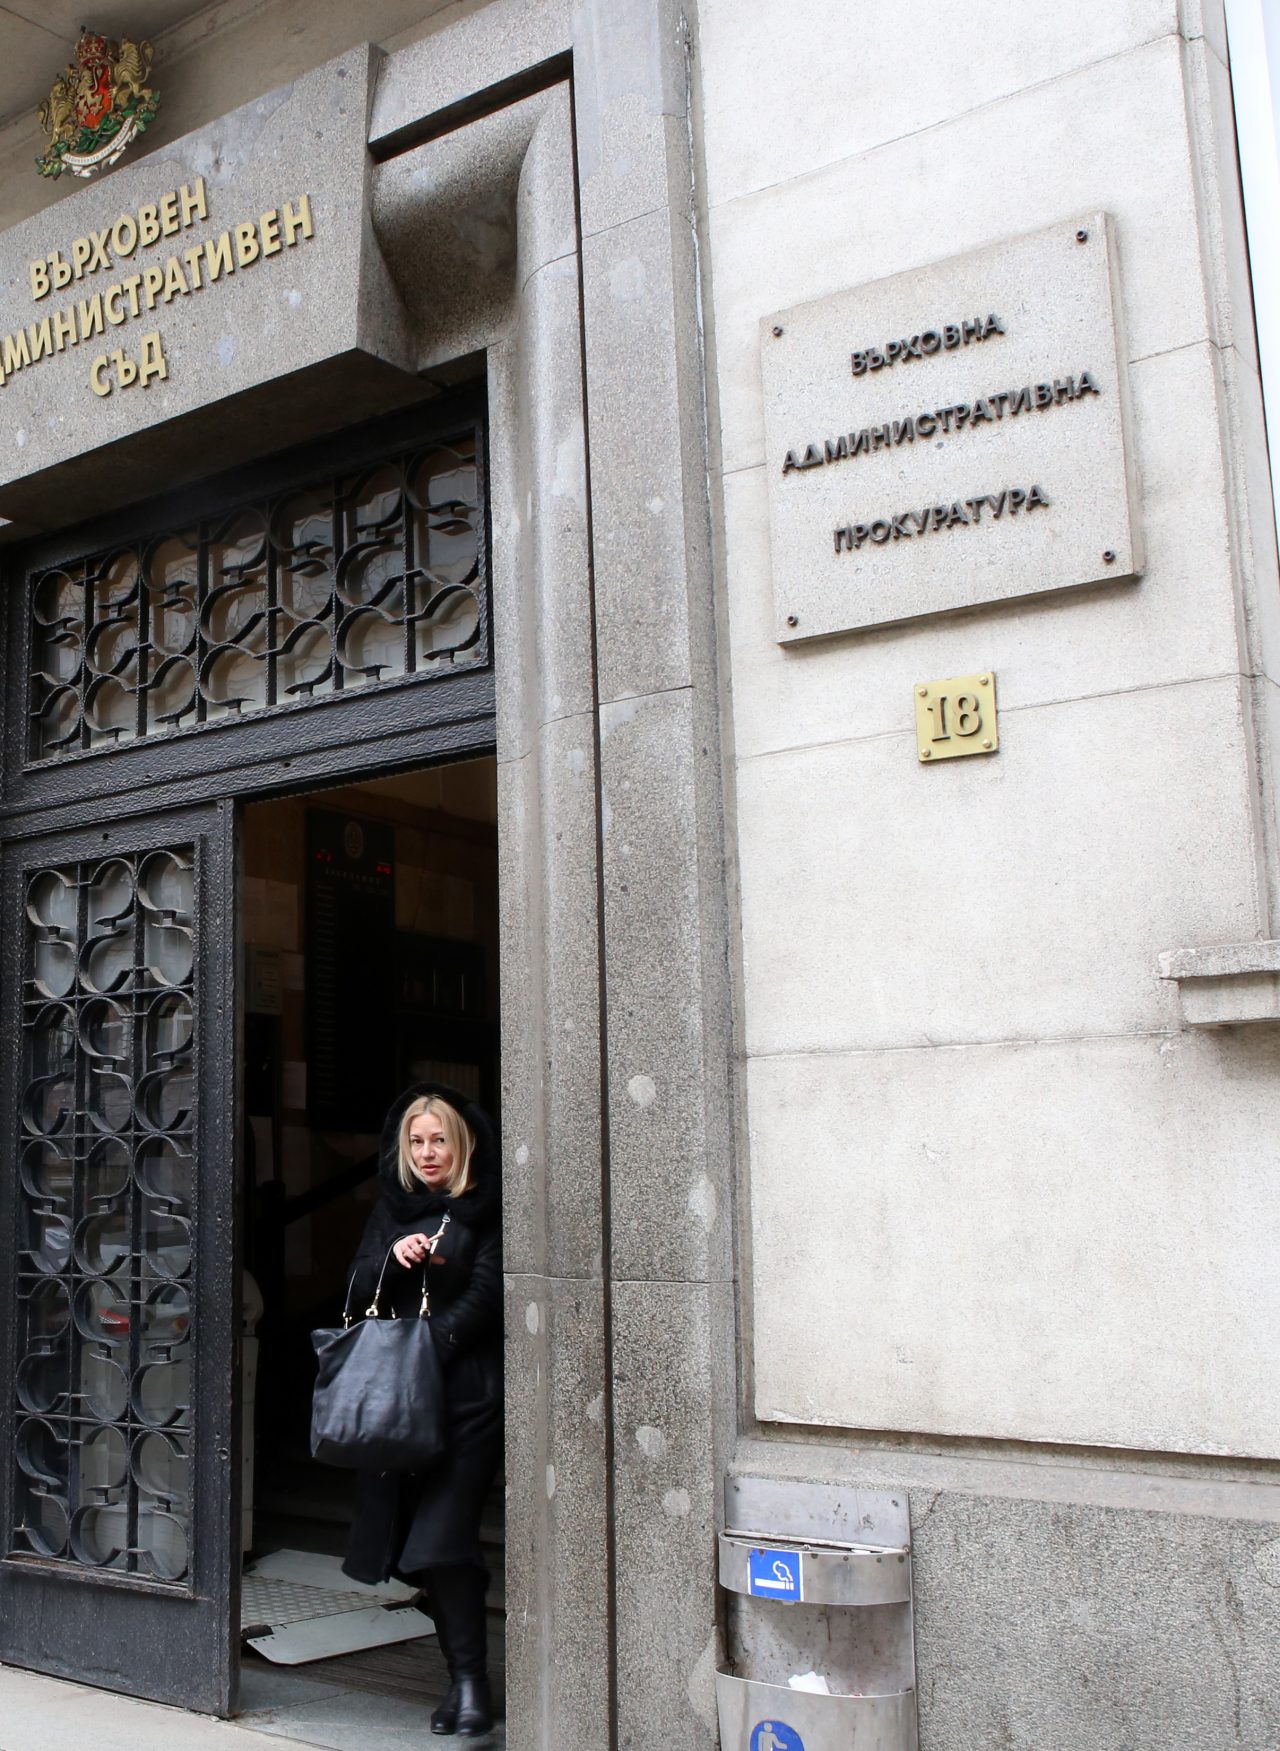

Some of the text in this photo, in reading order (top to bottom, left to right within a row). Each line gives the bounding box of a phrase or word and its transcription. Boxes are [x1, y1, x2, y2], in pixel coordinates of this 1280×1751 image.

[30, 177, 209, 301] ВЪРХОВЕН
[90, 331, 168, 397] СЪД
[850, 313, 1005, 376] ВЪРХОВНА
[782, 371, 1101, 474] АДМИНИСТРАТИВНА
[833, 484, 1049, 553] ПРОКУРАТУРА
[926, 694, 983, 743] 18
